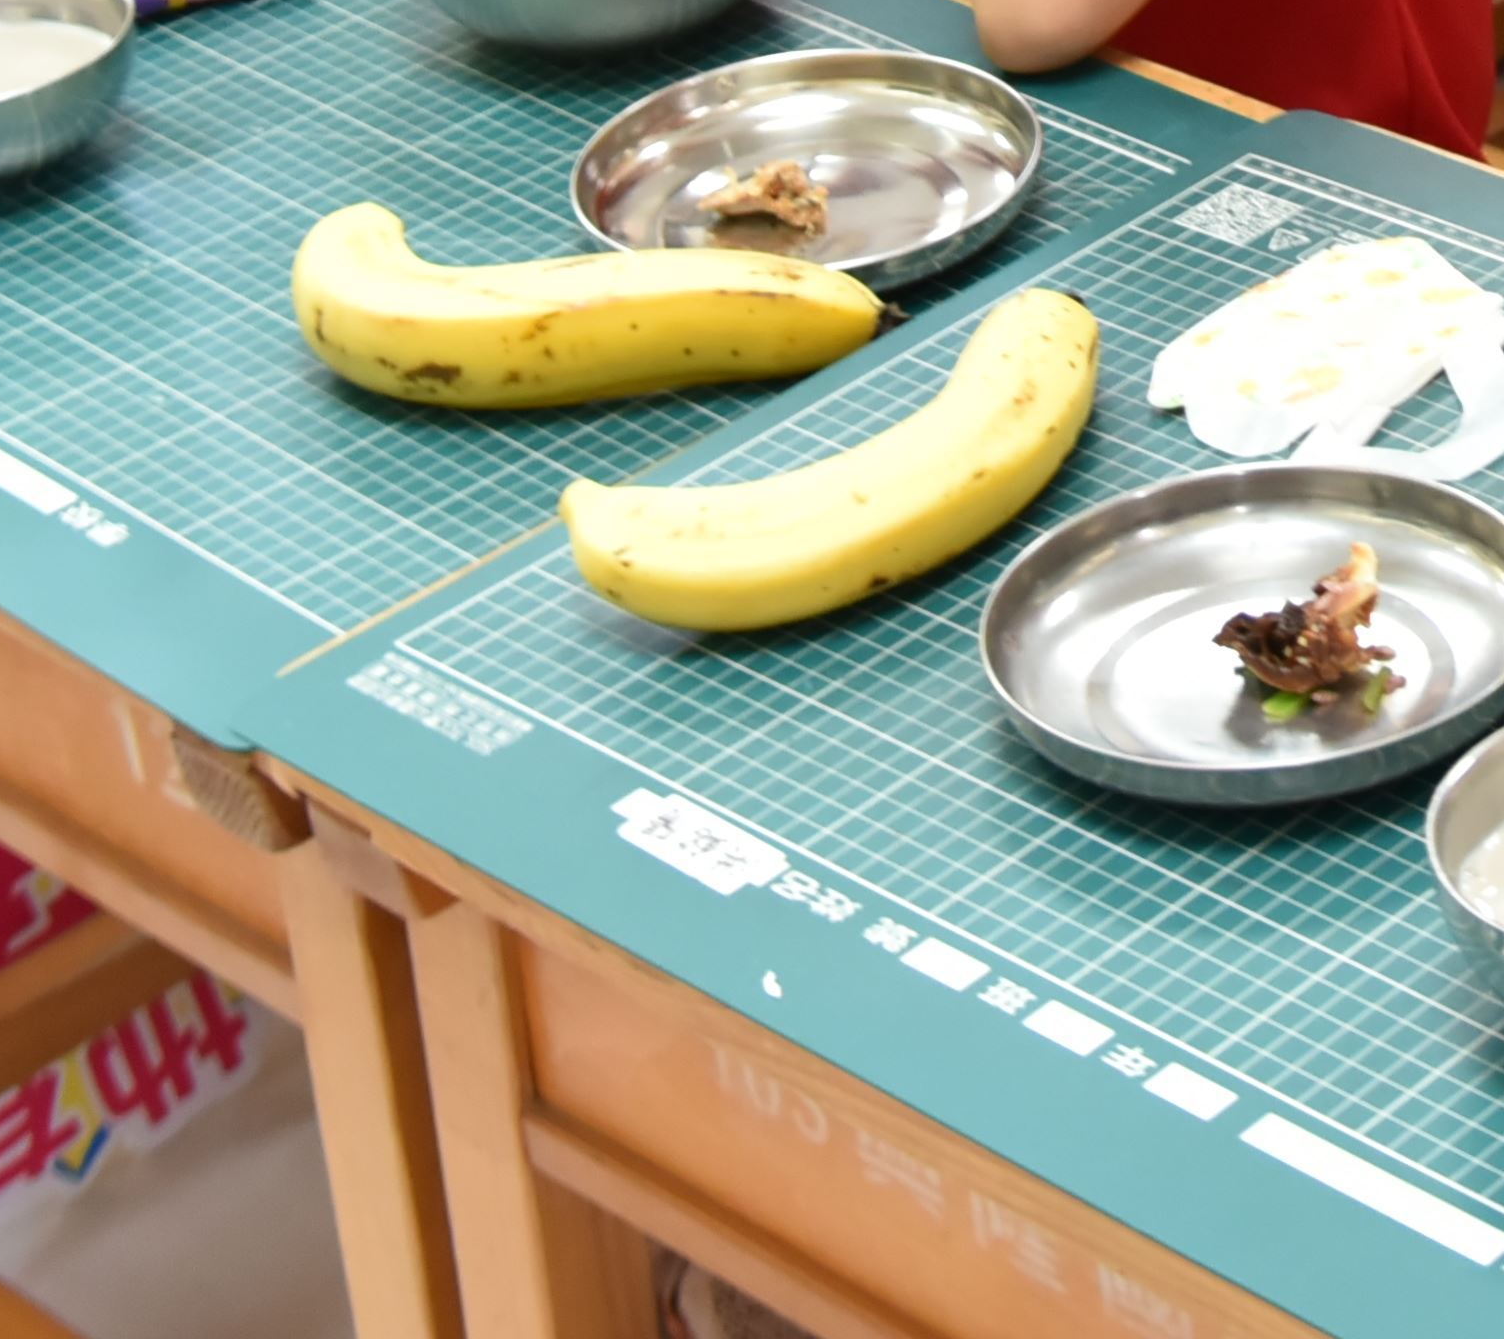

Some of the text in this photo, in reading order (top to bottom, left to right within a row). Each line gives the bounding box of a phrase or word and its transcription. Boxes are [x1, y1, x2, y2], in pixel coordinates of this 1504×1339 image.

[772, 868, 864, 924] 姓名
[976, 974, 1038, 1017] 班
[1102, 1041, 1158, 1081] 年
